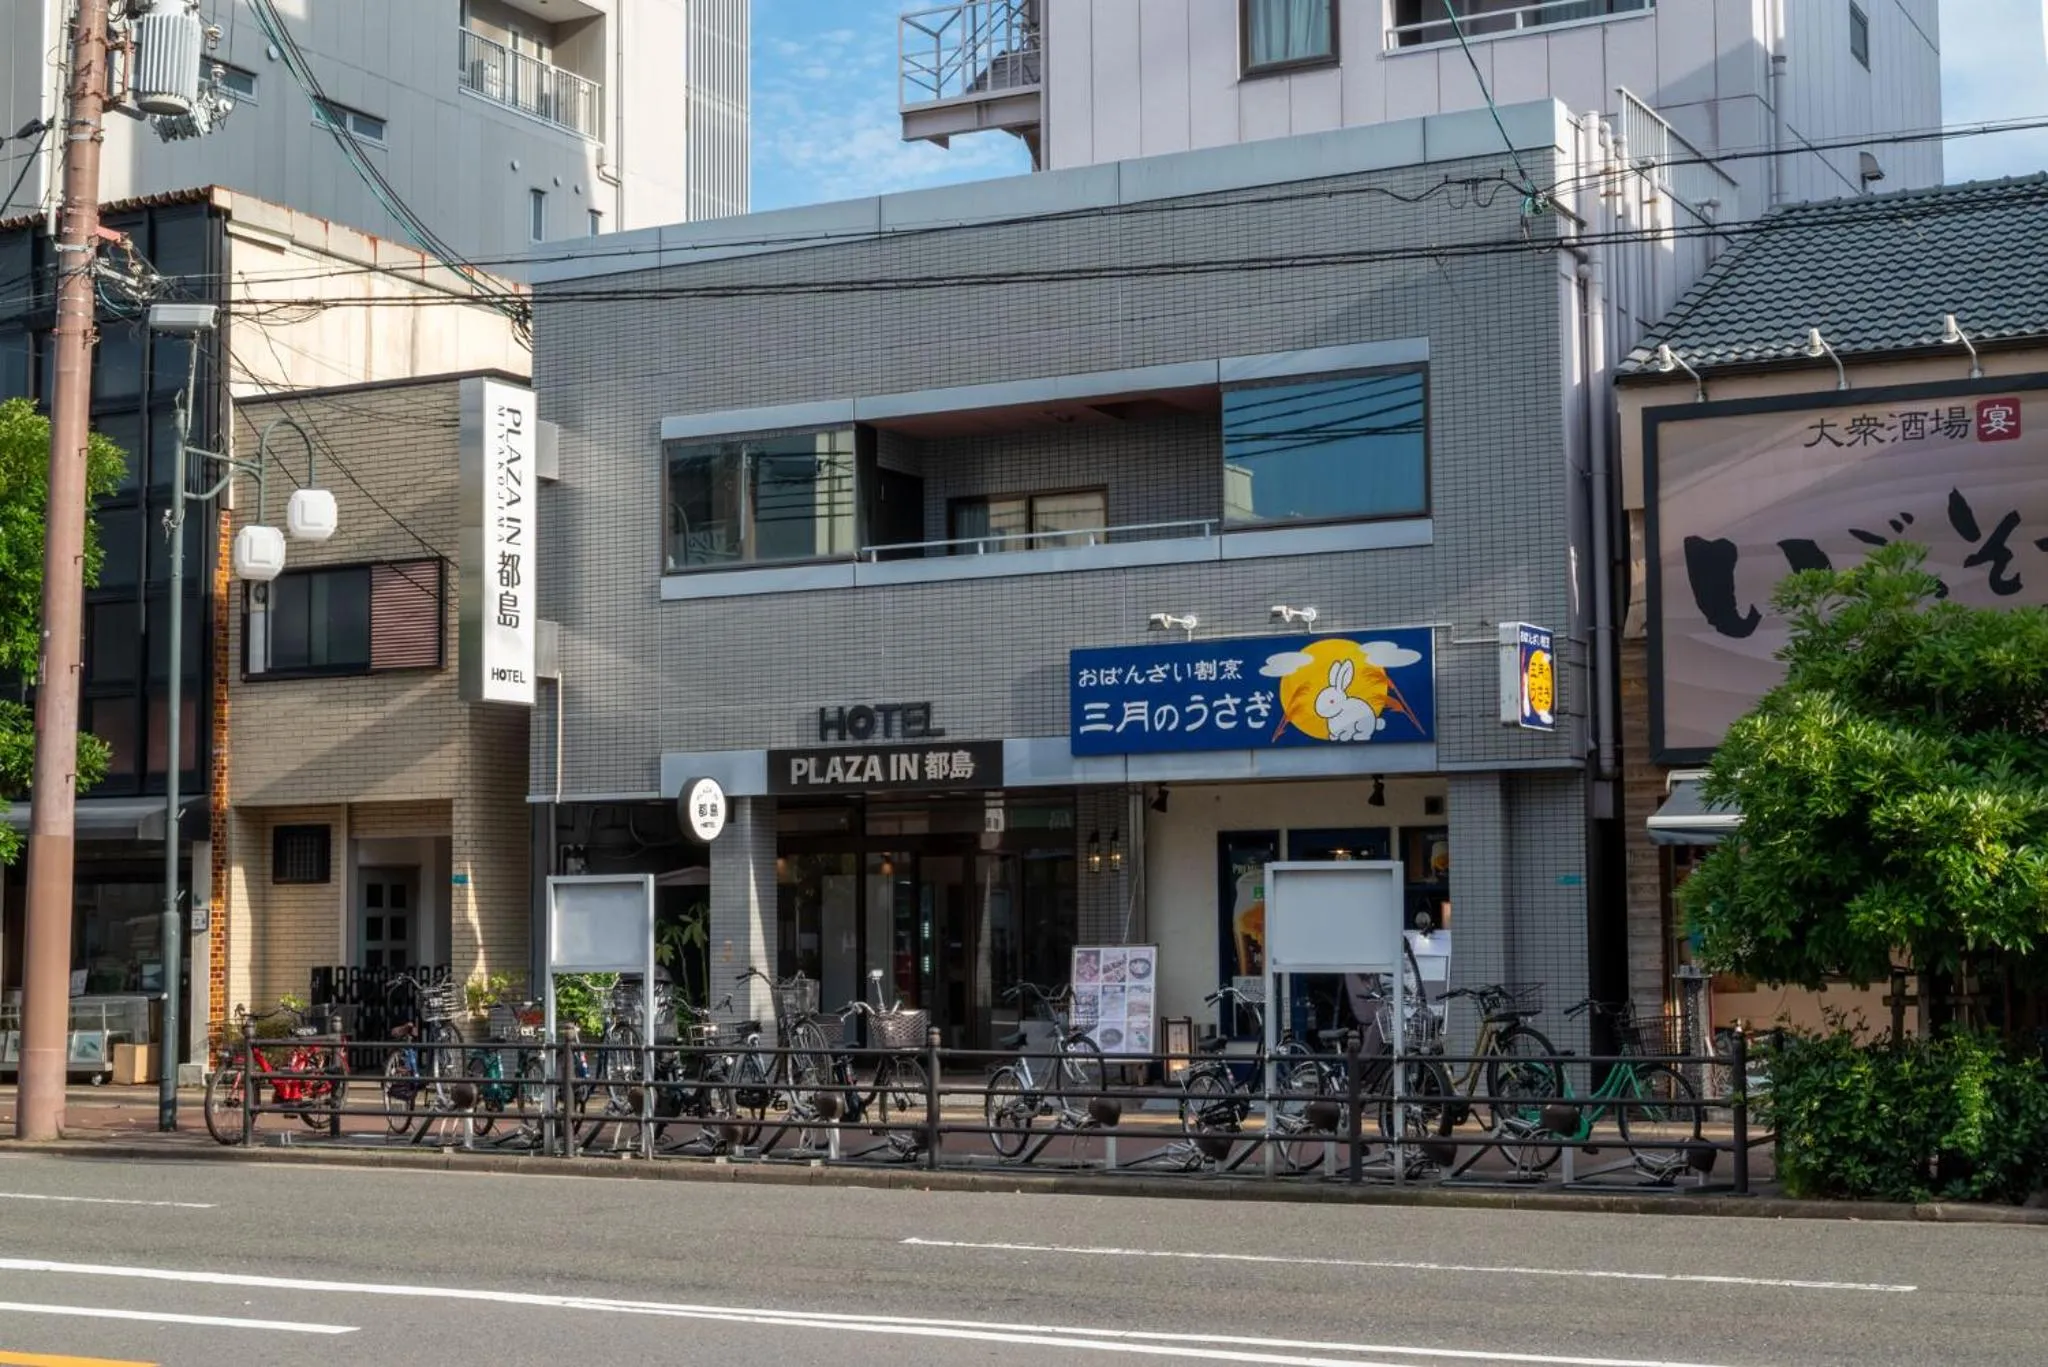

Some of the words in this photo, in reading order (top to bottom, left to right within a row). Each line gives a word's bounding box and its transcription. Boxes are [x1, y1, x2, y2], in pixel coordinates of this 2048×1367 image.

[1803, 406, 1973, 447] 大衆酒場
[1980, 403, 2016, 435] 宴
[506, 407, 522, 507] PLAZA
[505, 516, 522, 546] IN
[497, 549, 521, 629] 都島
[491, 667, 526, 684] HOTEL
[1078, 659, 1244, 687] おばんざい割烹
[818, 701, 946, 742] HOTEL
[1079, 690, 1275, 735] 三月のうさぎ
[790, 754, 884, 785] PLAZA
[889, 753, 920, 781] IN
[924, 750, 976, 780] 都島
